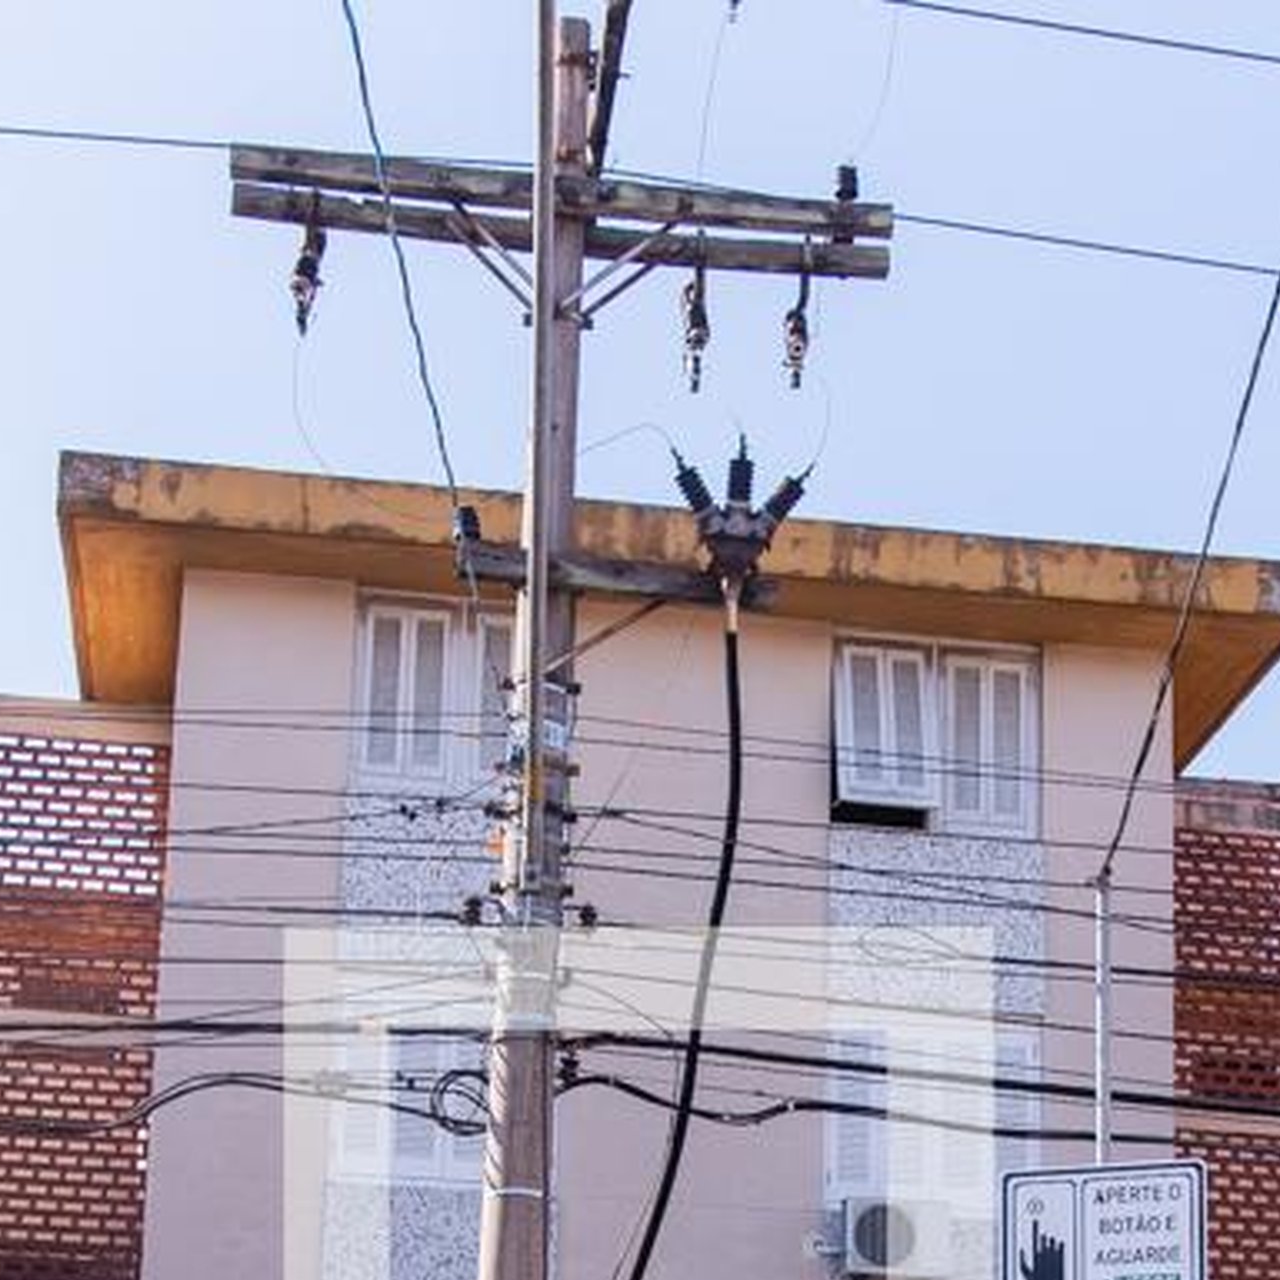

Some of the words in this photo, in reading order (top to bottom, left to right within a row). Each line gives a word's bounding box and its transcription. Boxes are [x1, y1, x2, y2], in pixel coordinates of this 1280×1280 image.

[1094, 1185, 1164, 1204] APERTE
[1169, 1184, 1181, 1202] O
[1099, 1213, 1161, 1235] BOTÃO
[1094, 1246, 1181, 1266] AGUARDE
